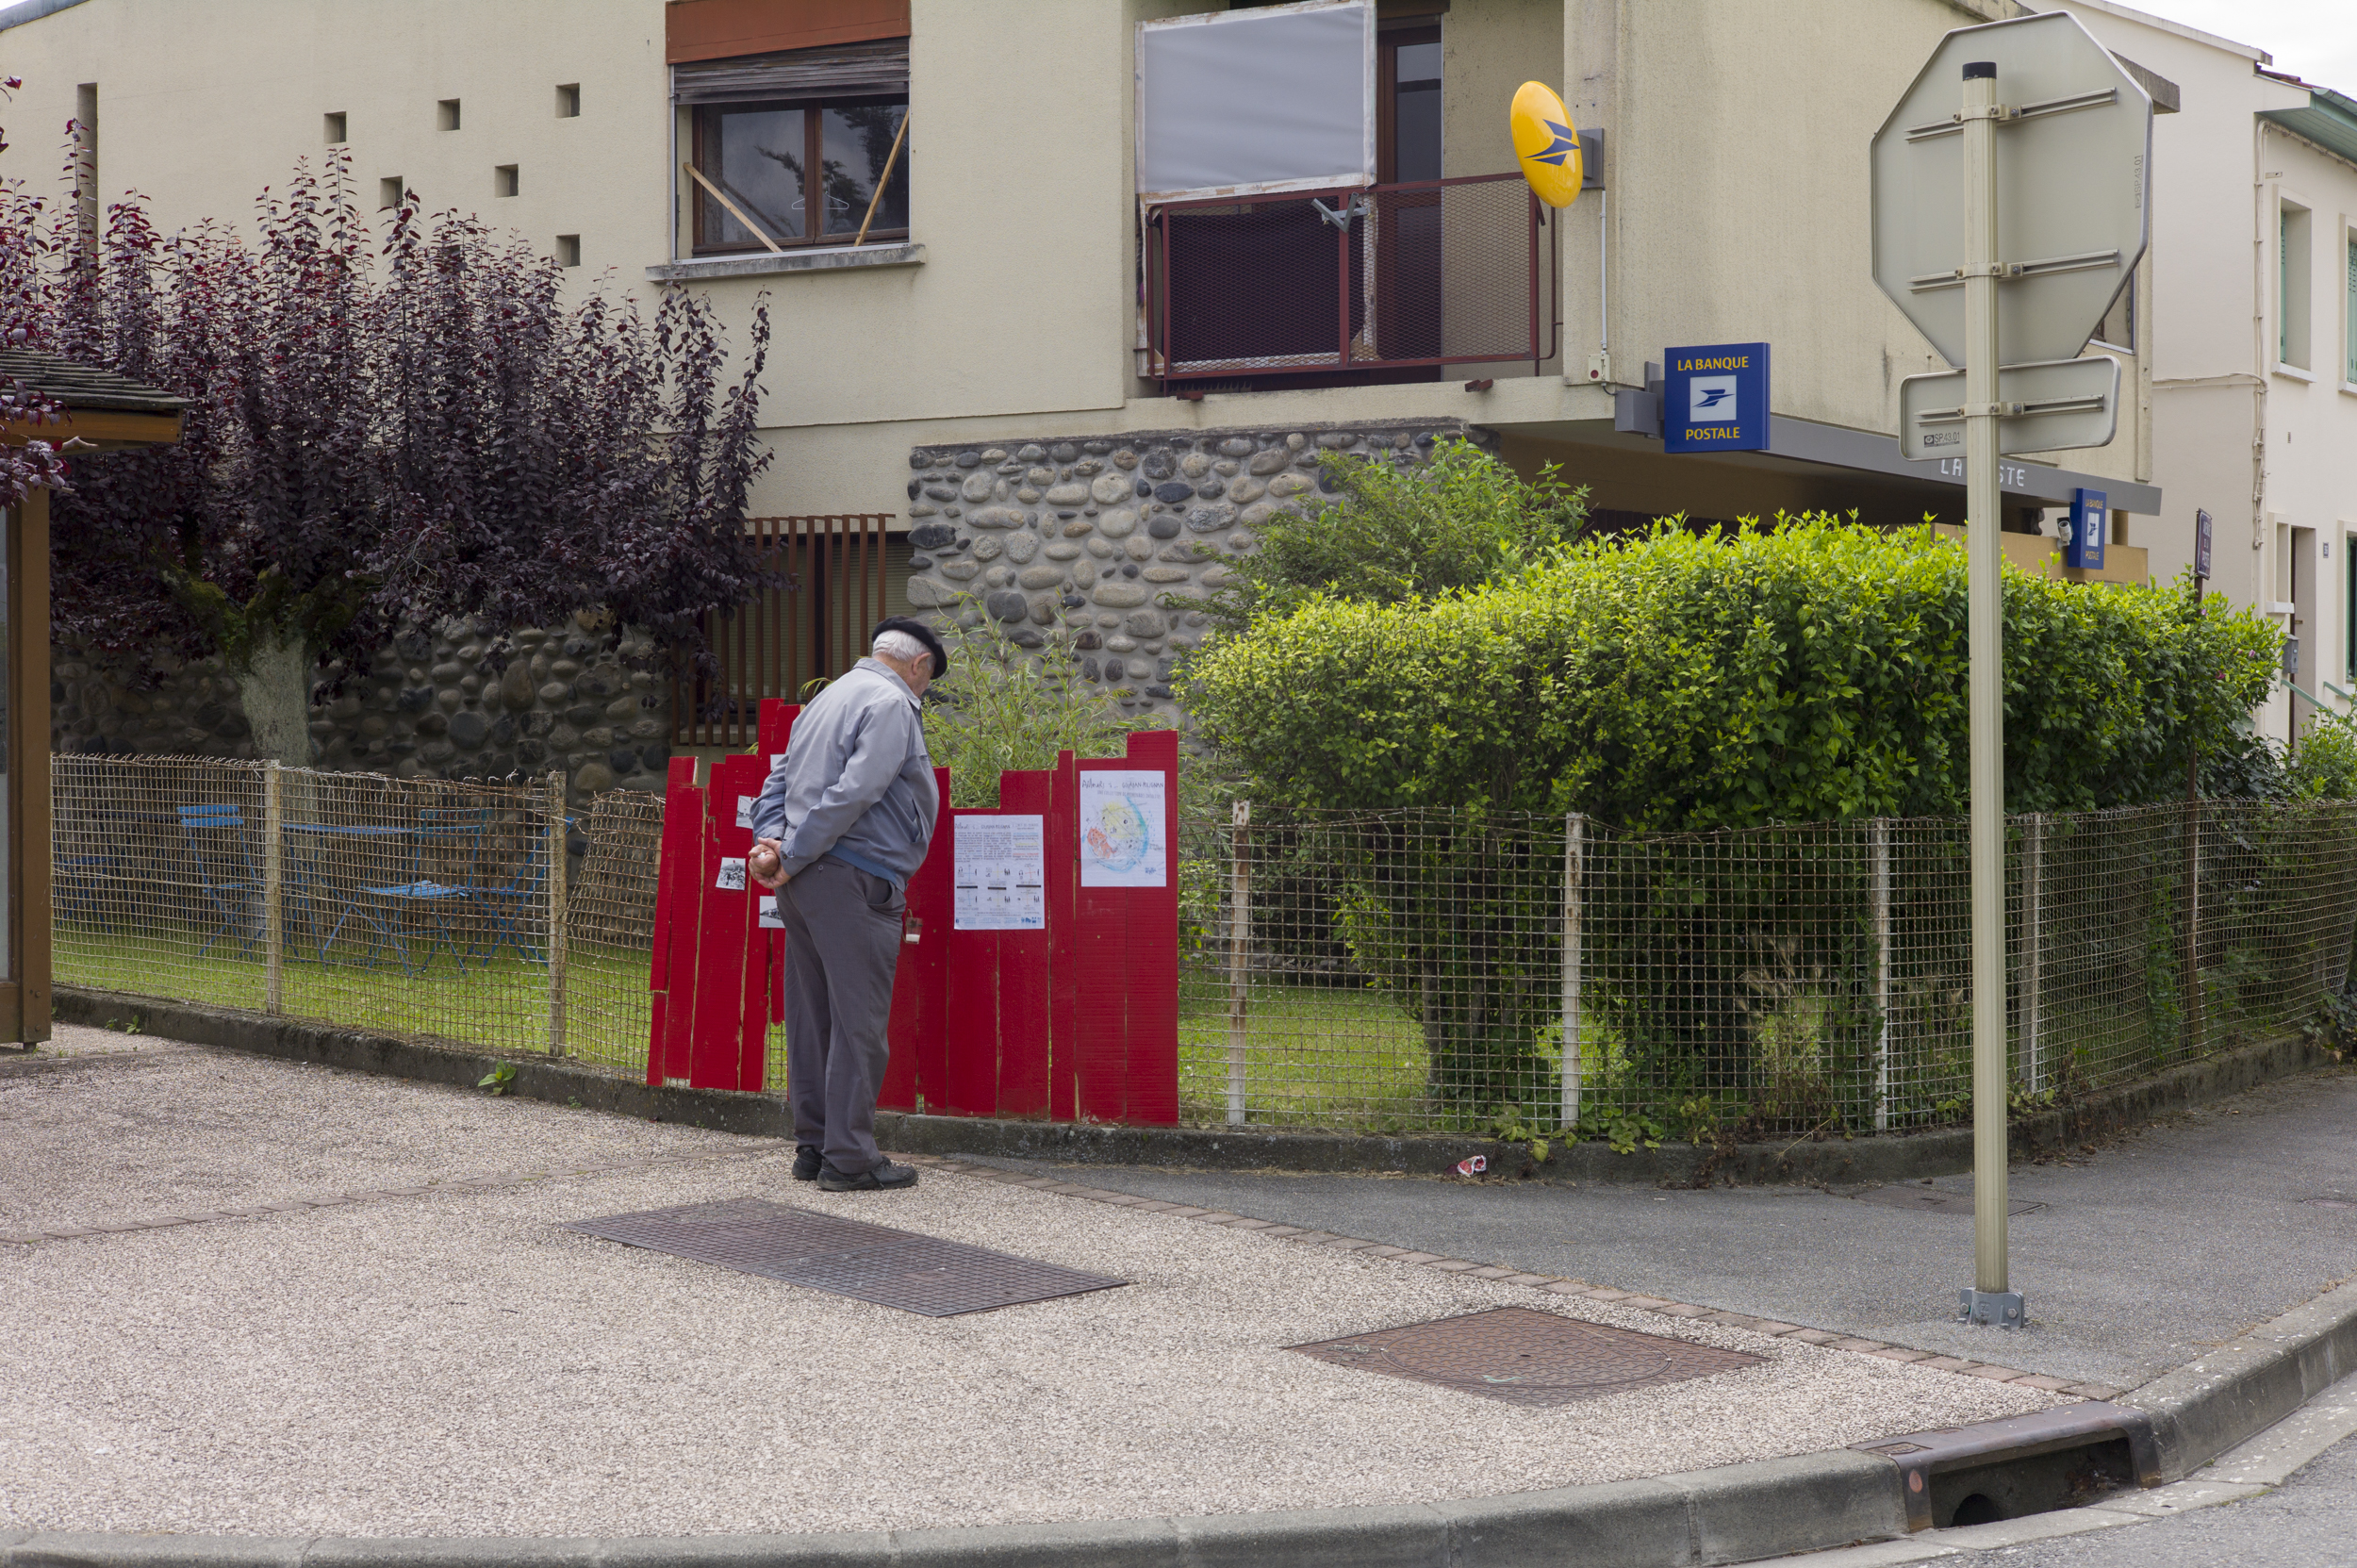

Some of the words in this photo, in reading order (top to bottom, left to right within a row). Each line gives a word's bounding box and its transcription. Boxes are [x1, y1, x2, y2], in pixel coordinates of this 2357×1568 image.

[1677, 359, 1693, 371] LA
[1695, 356, 1749, 371] BANQUE
[1686, 427, 1740, 440] POSTALE
[1934, 432, 1960, 443] SP.43.01
[1940, 458, 1963, 477] LA
